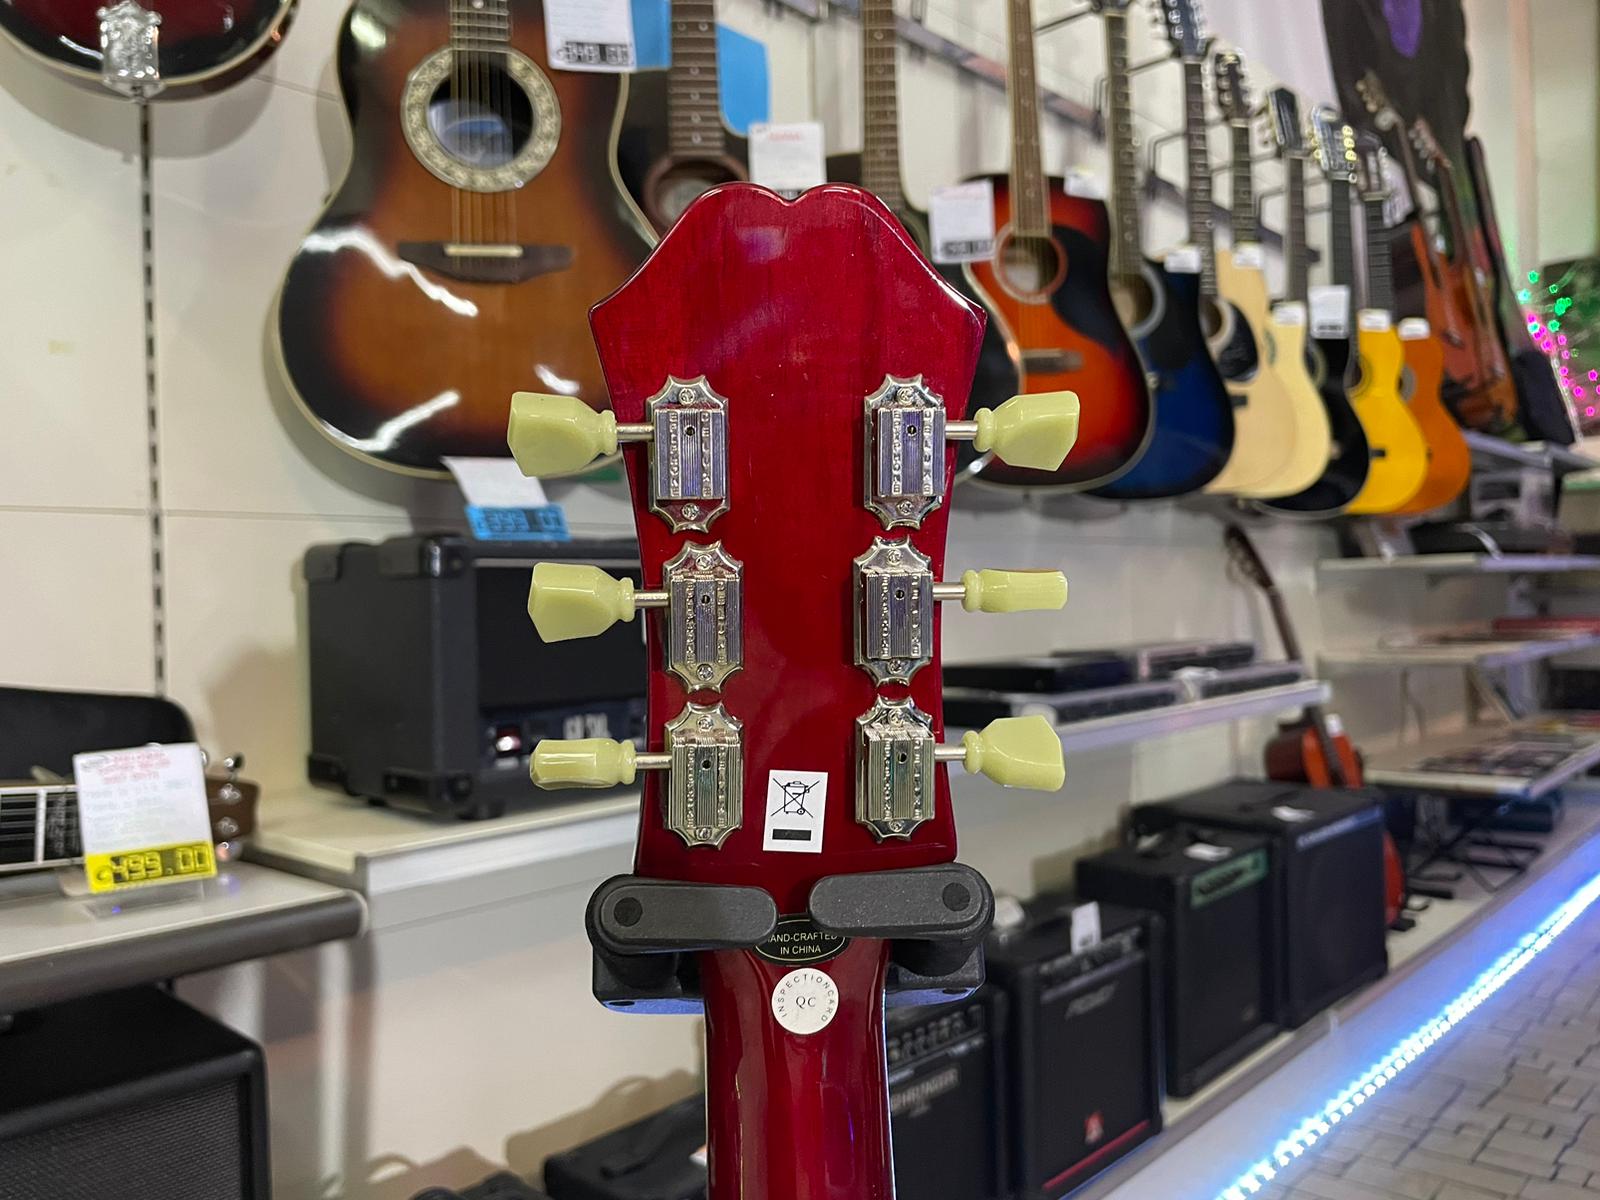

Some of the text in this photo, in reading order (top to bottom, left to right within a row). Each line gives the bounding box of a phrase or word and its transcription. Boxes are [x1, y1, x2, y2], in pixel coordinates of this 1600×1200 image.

[768, 931, 838, 943] AND-CRAFTED
[780, 944, 821, 955] IN CHINA
[795, 996, 817, 1009] QC
